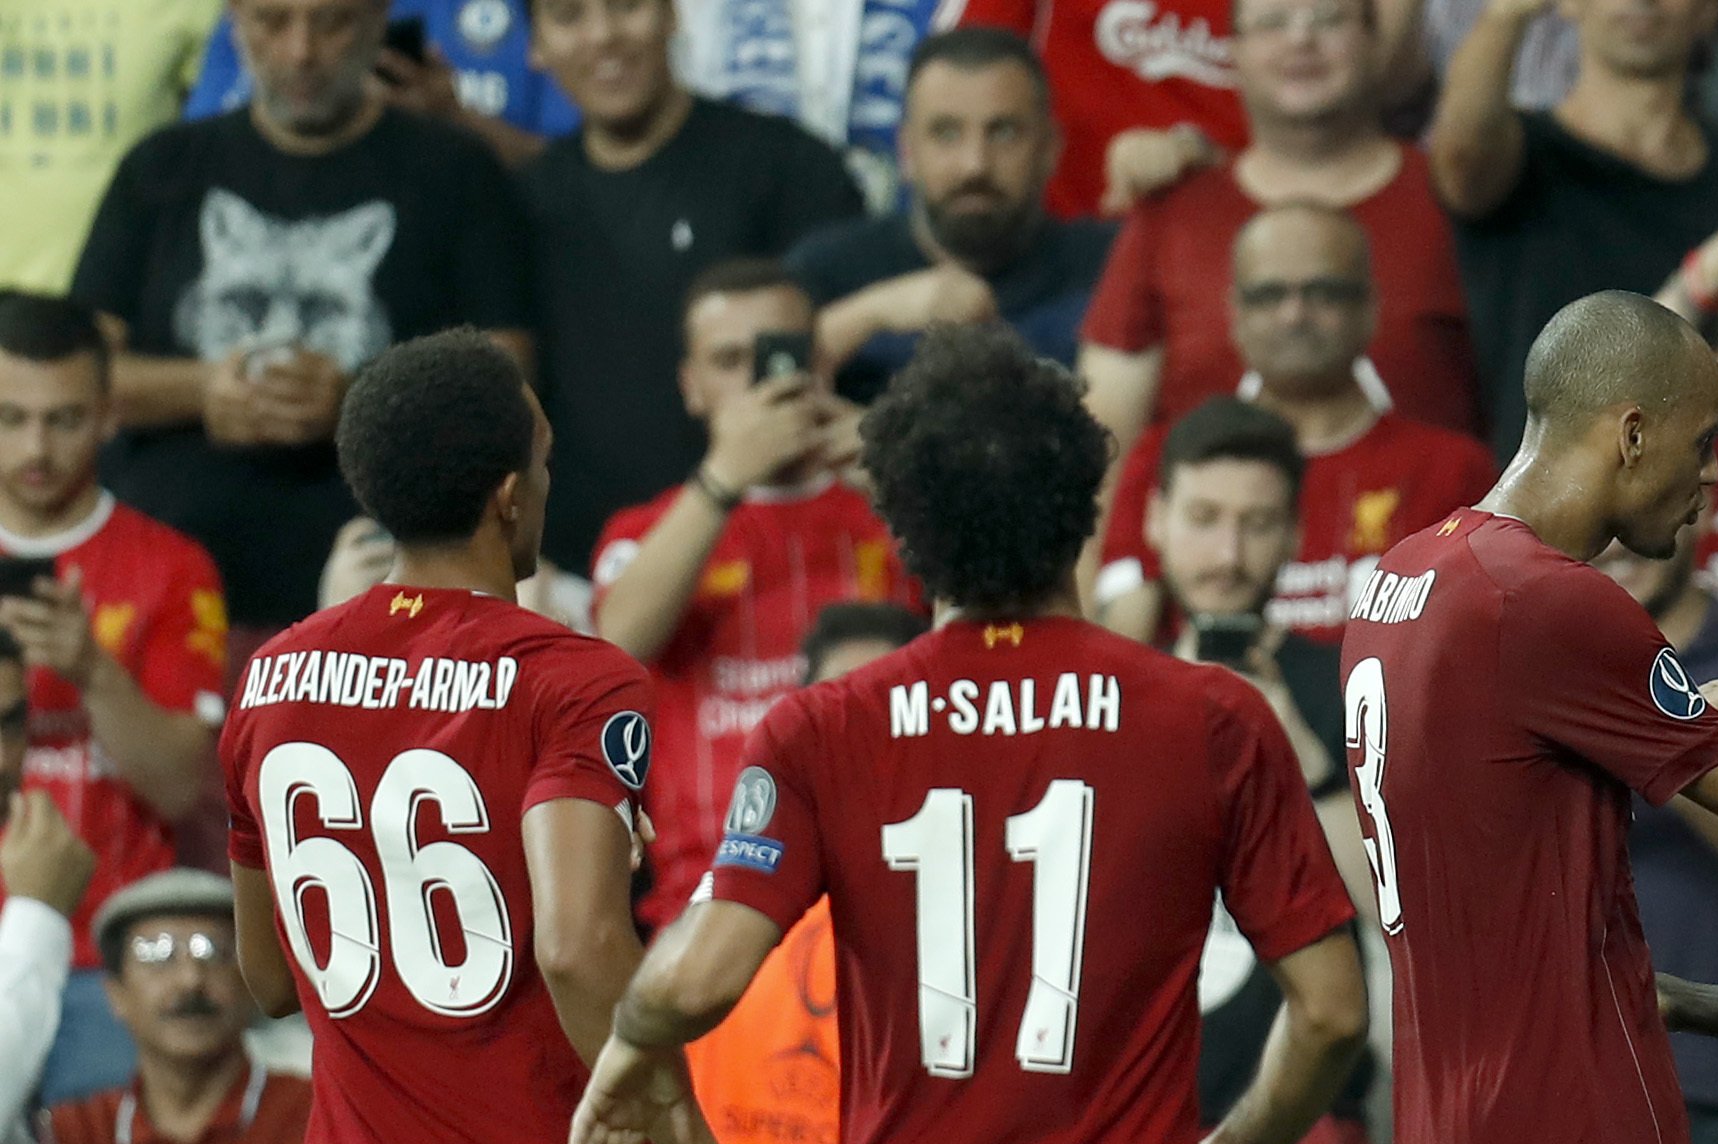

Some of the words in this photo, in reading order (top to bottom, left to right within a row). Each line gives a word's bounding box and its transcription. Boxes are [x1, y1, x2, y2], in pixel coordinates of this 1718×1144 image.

[258, 741, 514, 1018] 66
[720, 839, 782, 865] ESPECT
[881, 778, 1095, 1080] 11
[1345, 656, 1403, 935] 3
